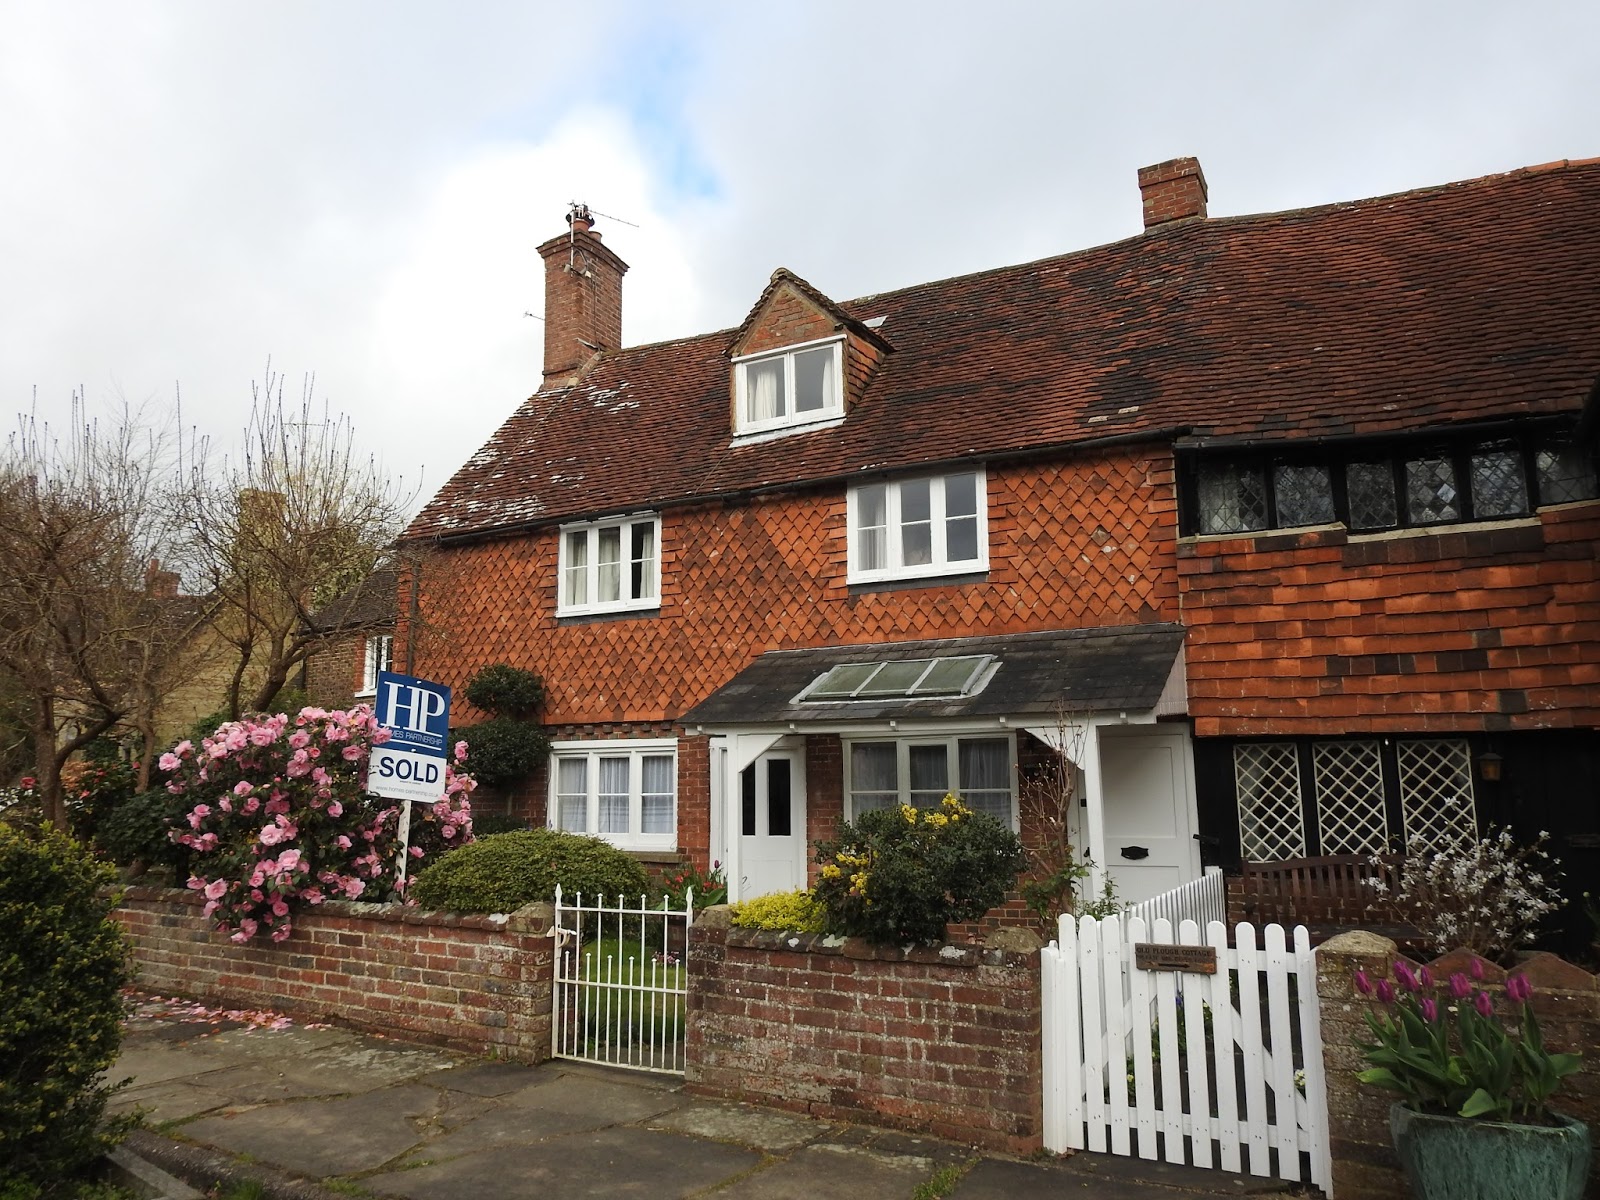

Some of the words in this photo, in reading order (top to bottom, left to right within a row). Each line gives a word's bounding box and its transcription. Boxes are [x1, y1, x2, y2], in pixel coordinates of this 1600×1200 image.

[380, 681, 445, 737] HP
[405, 731, 443, 746] PARTNERSHIP
[379, 756, 438, 784] SOLD
[1181, 949, 1211, 957] COTTAGE
